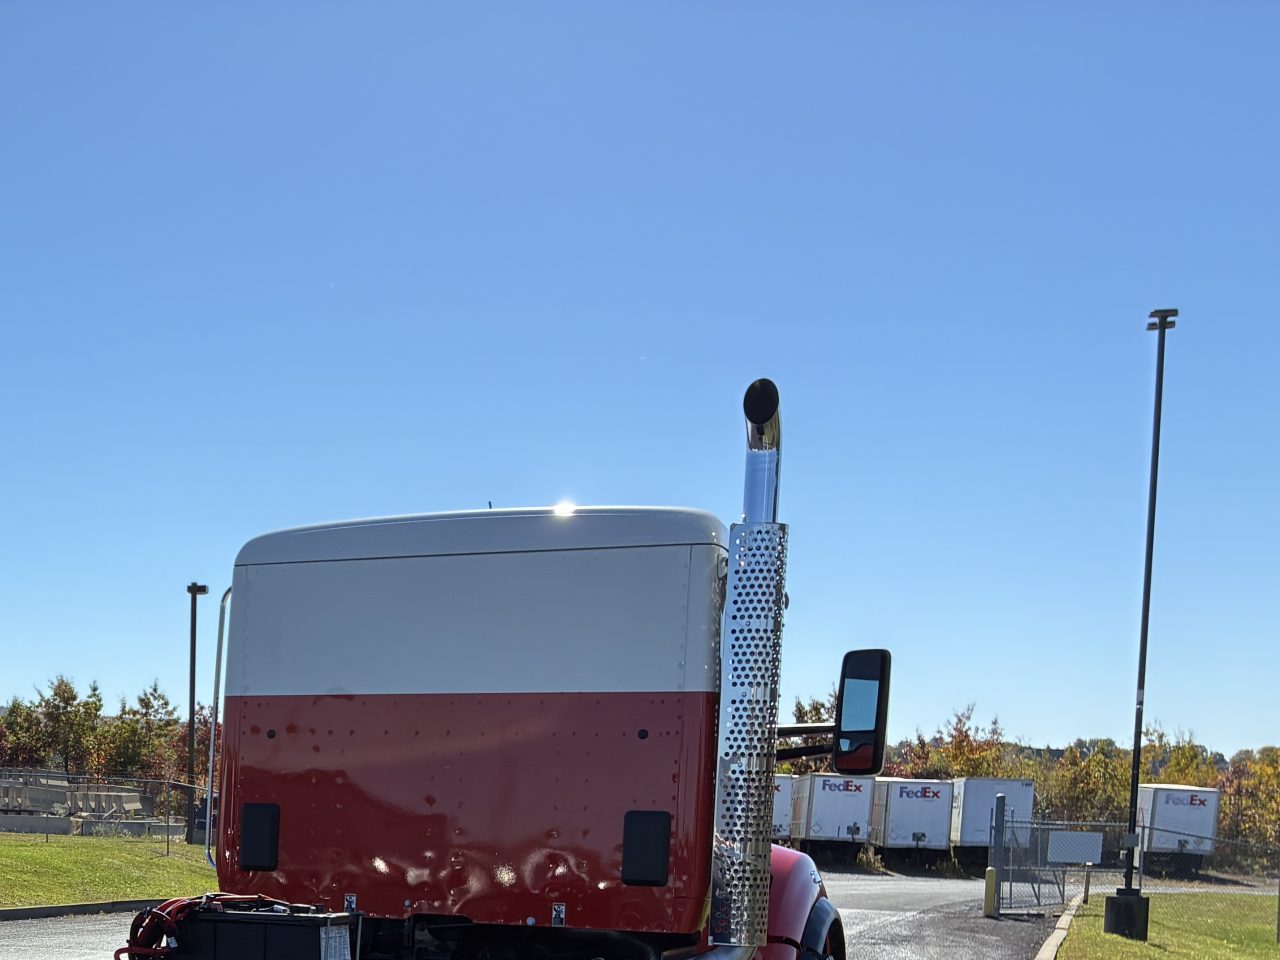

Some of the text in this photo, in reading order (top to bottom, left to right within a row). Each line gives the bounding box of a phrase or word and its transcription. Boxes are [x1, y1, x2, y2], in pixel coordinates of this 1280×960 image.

[821, 779, 863, 793] FedEx
[899, 786, 941, 799] FedEx
[1164, 793, 1208, 807] FedEx
